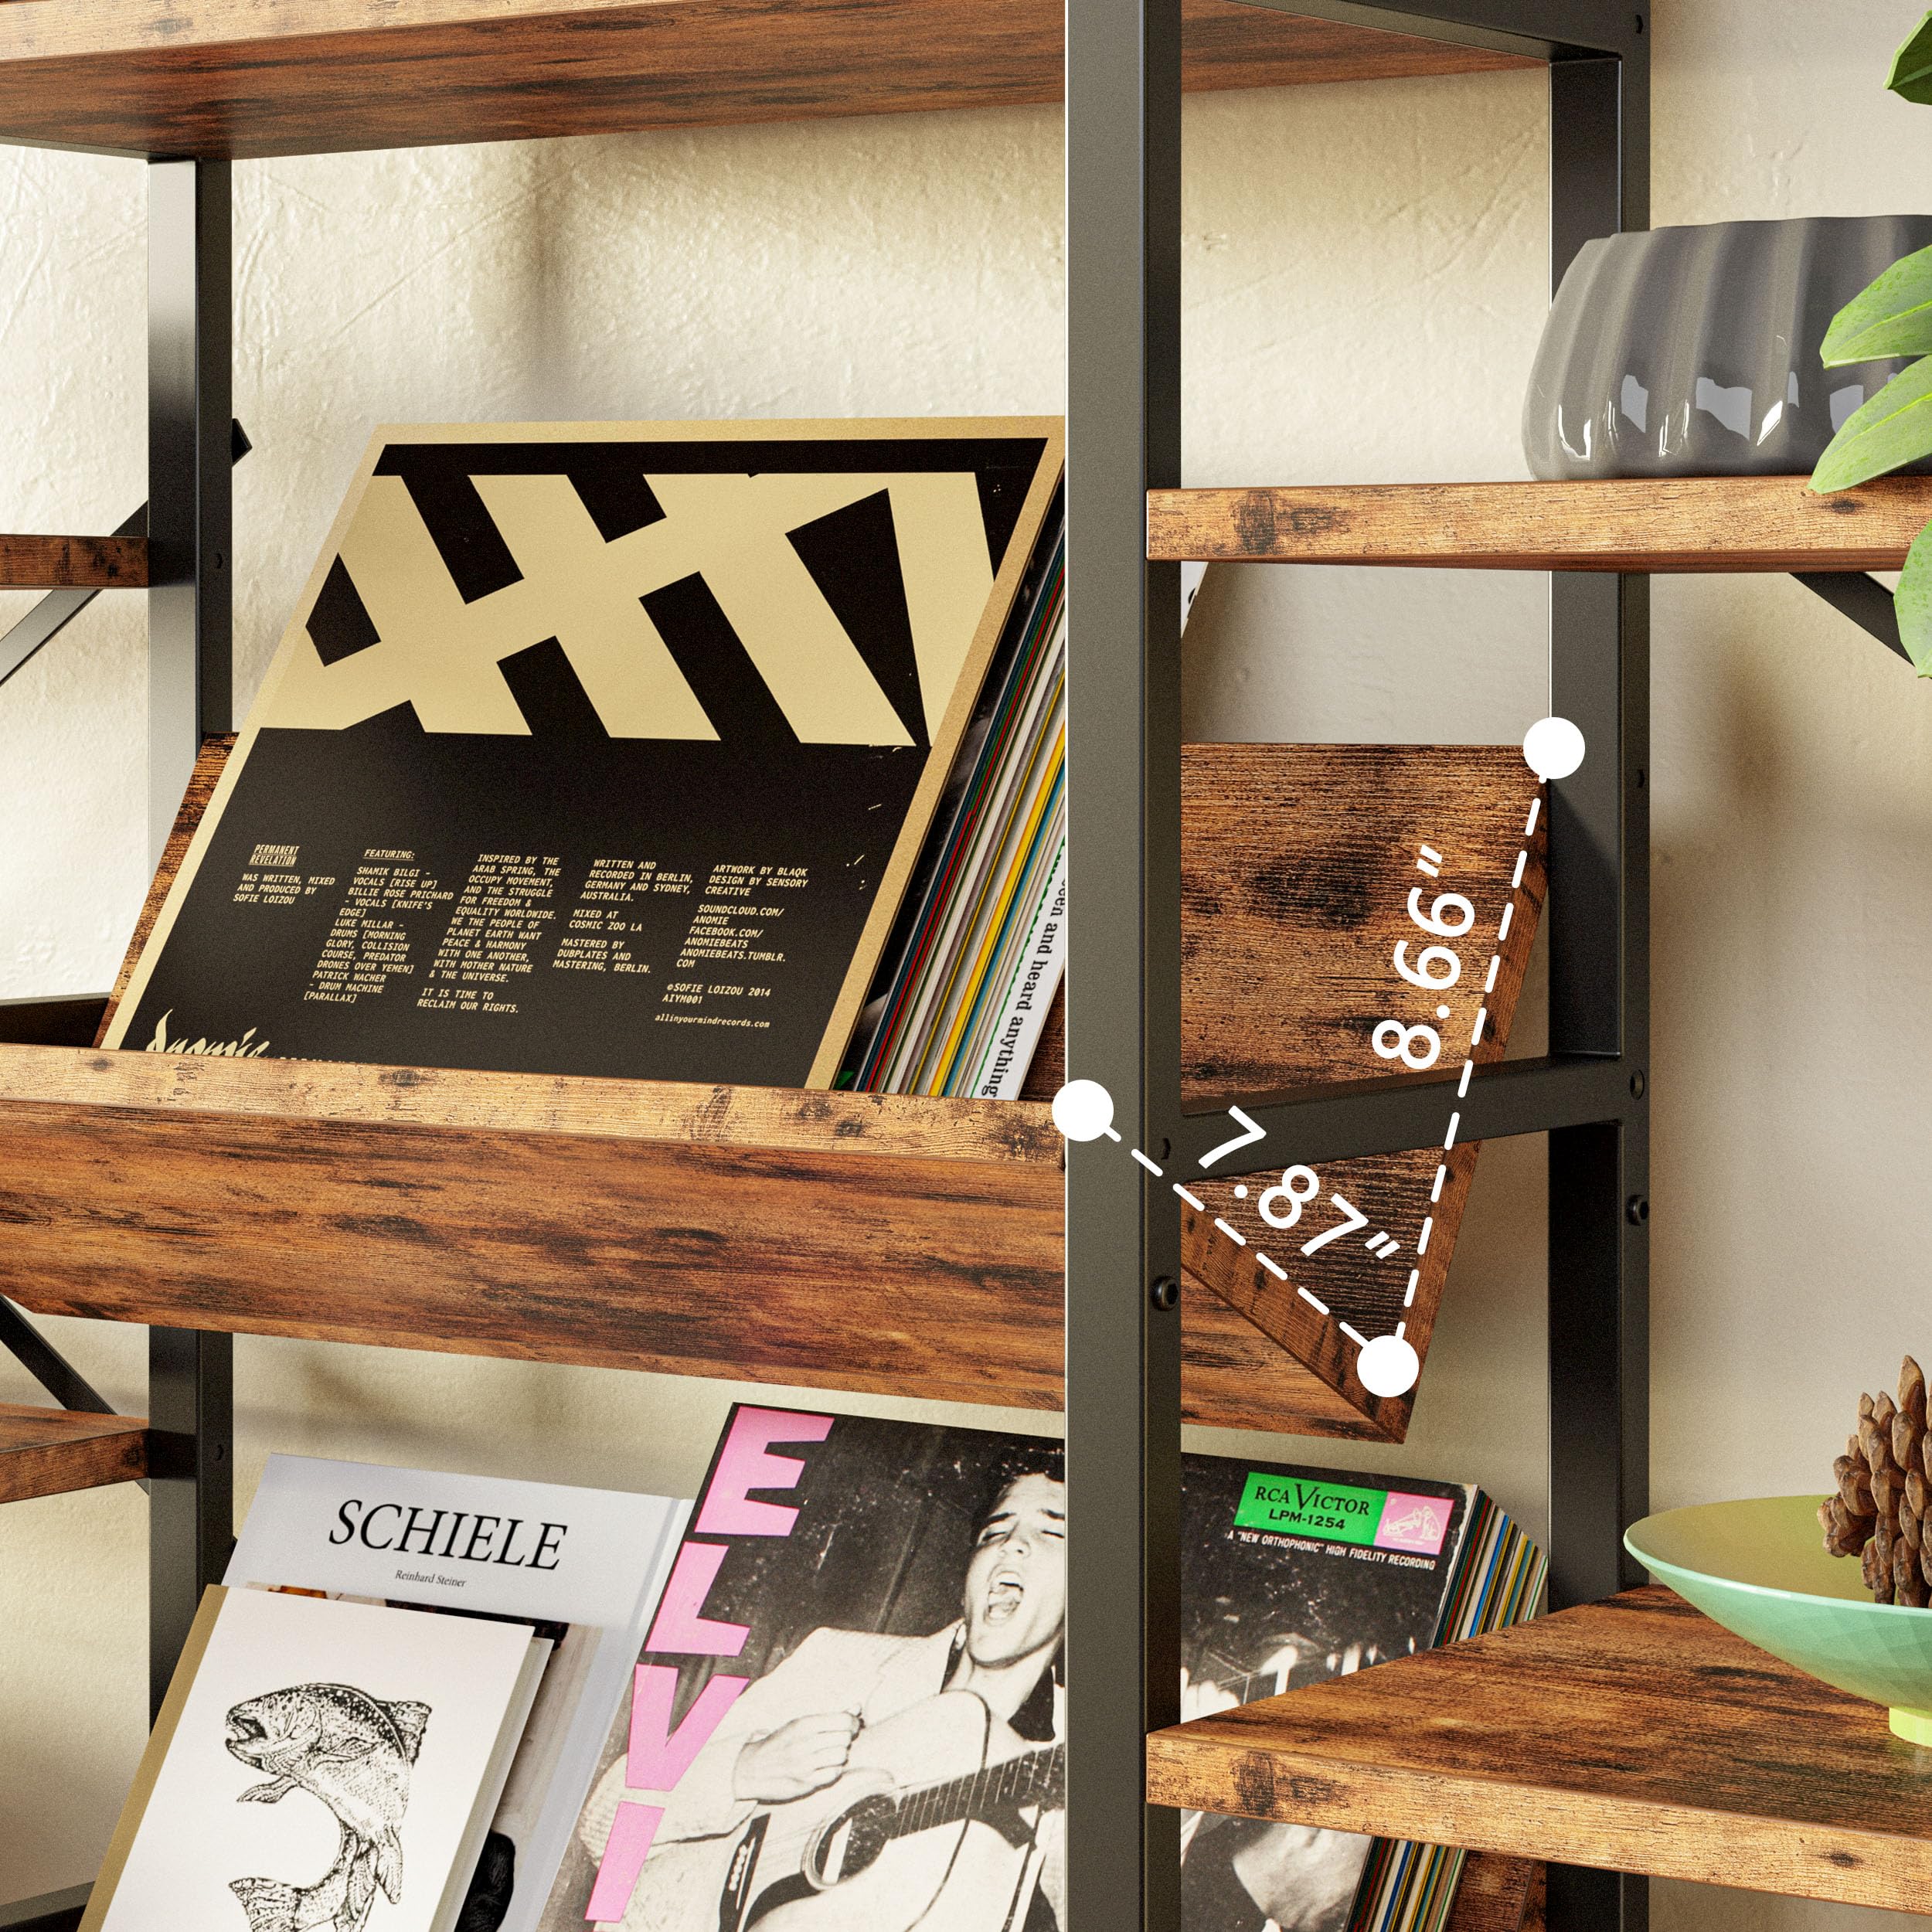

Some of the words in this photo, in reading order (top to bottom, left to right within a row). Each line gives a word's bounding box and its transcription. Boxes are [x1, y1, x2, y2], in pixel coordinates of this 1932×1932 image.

[253, 844, 300, 855] PERMANENT
[364, 849, 415, 859] FEATURING:
[249, 853, 298, 866] REVELATION
[477, 854, 521, 864] INSPIRED
[525, 855, 538, 865] BY
[543, 856, 560, 866] THE
[593, 859, 634, 869] WRITTEN
[637, 861, 657, 870] AND
[356, 866, 390, 876] SHAMIK
[393, 868, 420, 877] BILGI
[472, 864, 496, 873] ARAB
[500, 865, 536, 876] SPRING,
[544, 867, 562, 876] THE
[589, 869, 635, 880] RECORDED
[639, 872, 652, 881] IN
[655, 872, 693, 884] BERLIN,
[713, 864, 756, 875] ARTWORK
[759, 866, 774, 875] BY
[777, 867, 808, 878] BLAQK
[241, 872, 260, 882] WAS
[262, 874, 302, 886] WRITTEN,
[308, 876, 335, 886] MIXED
[353, 876, 386, 886] VOCALS
[389, 878, 417, 888] [RISE
[420, 879, 438, 889] UP]
[468, 874, 503, 884] OCCUPY
[505, 876, 553, 888] MOVEMENT,
[709, 875, 745, 885] DESIGN
[748, 876, 762, 886] BY
[766, 877, 809, 888] SENSORY
[236, 883, 255, 892] AND
[257, 883, 301, 894] PRODUCED
[304, 886, 318, 895] BY
[347, 886, 380, 896] BILLIE
[383, 889, 406, 898] ROSE
[410, 889, 454, 900] PRICHARD
[463, 885, 482, 894] AND
[487, 886, 505, 896] THE
[508, 887, 553, 898] STRUGGLE
[584, 879, 627, 890] GERMANY
[629, 883, 649, 892] AND
[652, 883, 690, 895] SYDNEY,
[705, 886, 752, 896] CREATIVE
[233, 893, 260, 903] SOFIE
[263, 895, 296, 905] LOIZOU
[355, 897, 388, 908] VOCALS
[459, 896, 478, 905] FOR
[481, 896, 522, 906] FREEDOM
[525, 899, 532, 907] &
[580, 891, 634, 902] AUSTRALIA.
[1050, 877, 1066, 917] een
[338, 907, 367, 918] EDGE]
[455, 906, 501, 917] EQUALITY
[504, 909, 556, 920] WORLDWIDE.
[573, 909, 602, 919] MIXED
[605, 910, 619, 920] AT
[697, 904, 785, 917] SOUNDCLOUD.COM/
[334, 918, 358, 927] LUKE
[360, 920, 394, 930] MILLAR
[451, 917, 464, 926] WE
[468, 917, 486, 927] THE
[489, 918, 524, 929] PEOPLE
[527, 920, 540, 930] OF
[569, 919, 604, 930] COSMIC
[607, 921, 626, 931] ZOO
[630, 923, 642, 932] LA
[692, 915, 730, 925] ANOMIE
[329, 928, 359, 938] DRUMS
[362, 930, 406, 941] [MORNING
[446, 927, 481, 937] PLANET
[485, 929, 515, 939] EARTH
[518, 931, 543, 940] WANT
[689, 926, 764, 938] FACEBOOK.COM/
[325, 938, 355, 950] GLORY,
[361, 940, 410, 951] COLLISION
[441, 937, 471, 947] PEACE
[474, 939, 481, 948] &
[485, 940, 527, 951] HARMONY
[560, 937, 607, 949] MASTERED
[611, 940, 625, 950] BY
[684, 937, 749, 949] ANOMIEBEATS
[1037, 923, 1057, 956] and
[321, 949, 356, 961] COURSE,
[362, 951, 406, 962] PREDATOR
[437, 948, 461, 957] WITH
[464, 950, 484, 959] ONE
[486, 951, 529, 963] ANOTHER,
[556, 948, 608, 960] DUBPLATES
[611, 951, 631, 961] AND
[679, 947, 786, 962] ANOMIEBEATS.TUMBLR.
[316, 959, 350, 970] DRONES
[354, 961, 377, 971] OVER
[382, 964, 415, 975] YEMEN]
[433, 959, 457, 968] WITH
[460, 961, 495, 971] MOTHER
[498, 962, 534, 973] NATURE
[552, 959, 607, 972] MASTERING,
[613, 962, 651, 974] BERLIN.
[676, 958, 696, 968] COM
[311, 970, 350, 981] PATRICK
[353, 973, 387, 983] WACHER
[428, 969, 436, 978] &
[440, 970, 458, 980] THE
[461, 971, 509, 983] UNIVERSE.
[318, 981, 342, 991] DRUM
[345, 983, 385, 994] MACHINE
[707, 985, 744, 996] LOIZOU
[747, 987, 771, 997] 2014
[1016, 959, 1048, 1011] heard
[303, 991, 358, 1004] [PARALLAX]
[421, 988, 434, 997] IT
[437, 988, 451, 998] IS
[455, 989, 478, 999] TIME
[482, 991, 495, 1001] TO
[417, 998, 457, 1009] RECLAIM
[460, 1001, 479, 1011] OUR
[481, 1002, 519, 1014] RIGHTS.
[981, 1016, 1024, 1098] anything
[1254, 1485, 1291, 1505] RCA
[1294, 1483, 1370, 1515] VICTOR
[1268, 1509, 1346, 1530] LPM-1254
[328, 1498, 568, 1571] SCHIELE
[1226, 1529, 1235, 1541] A
[1325, 1546, 1347, 1556] HIGH
[1349, 1547, 1387, 1563] FIDELITY
[1387, 1554, 1437, 1571] RECORDING
[395, 1569, 435, 1584] Reinhard
[435, 1574, 467, 1588] Steiner
[585, 1406, 835, 1932] ELVI
